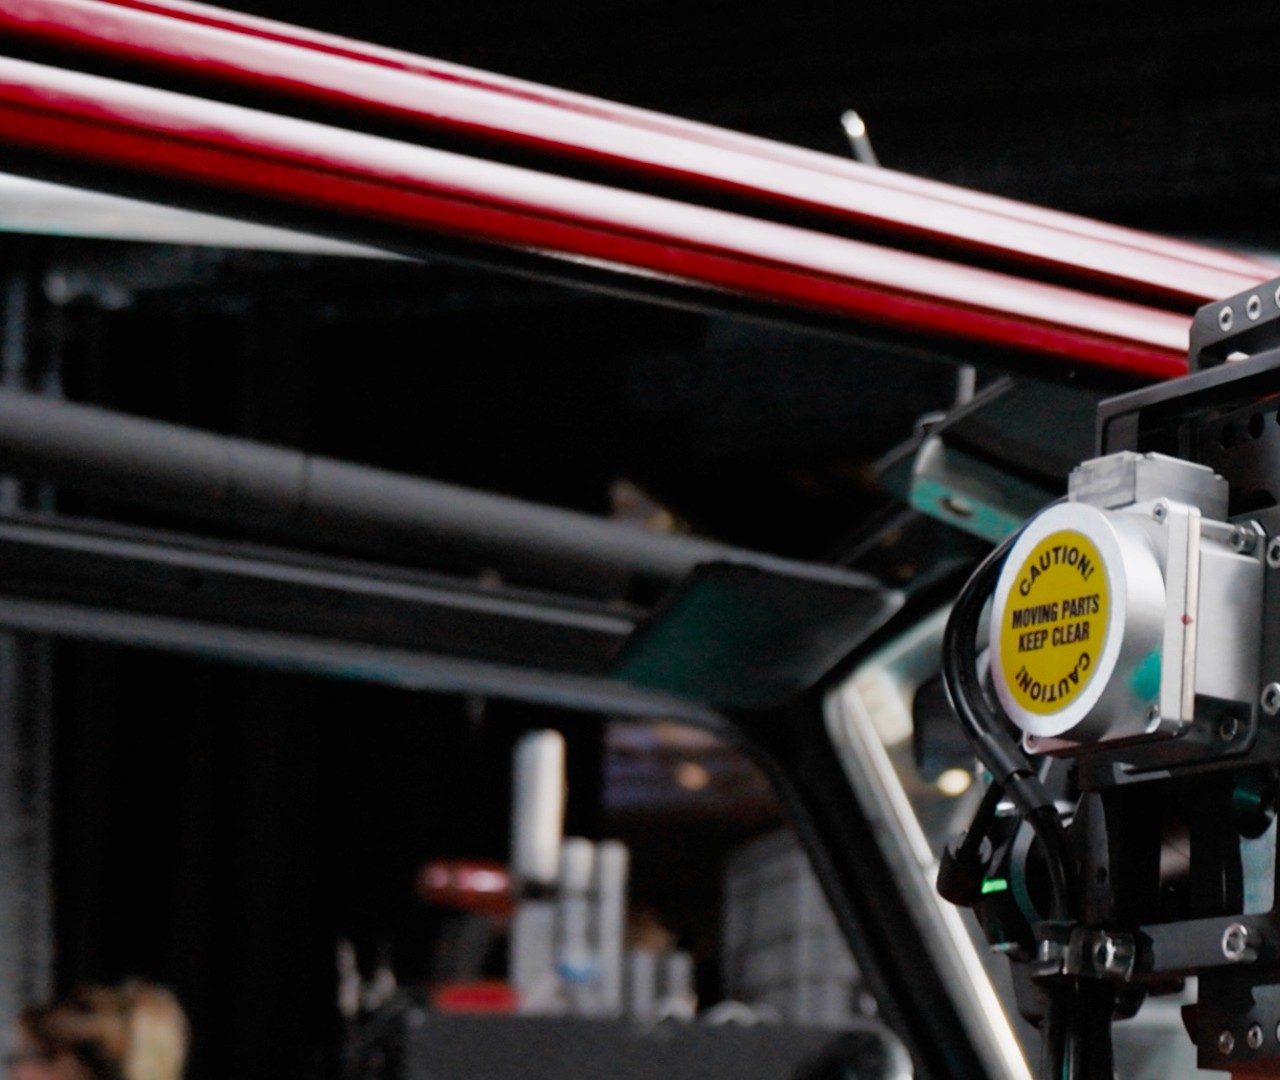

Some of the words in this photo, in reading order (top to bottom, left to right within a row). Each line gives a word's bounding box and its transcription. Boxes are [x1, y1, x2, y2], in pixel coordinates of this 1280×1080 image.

[1018, 544, 1095, 598] CAUTION!
[1011, 602, 1059, 630] MOVING
[1061, 594, 1101, 621] PARTS
[1017, 628, 1049, 654] KEEP
[1051, 621, 1091, 648] CLEAR
[1014, 652, 1091, 703] CAUTION!
